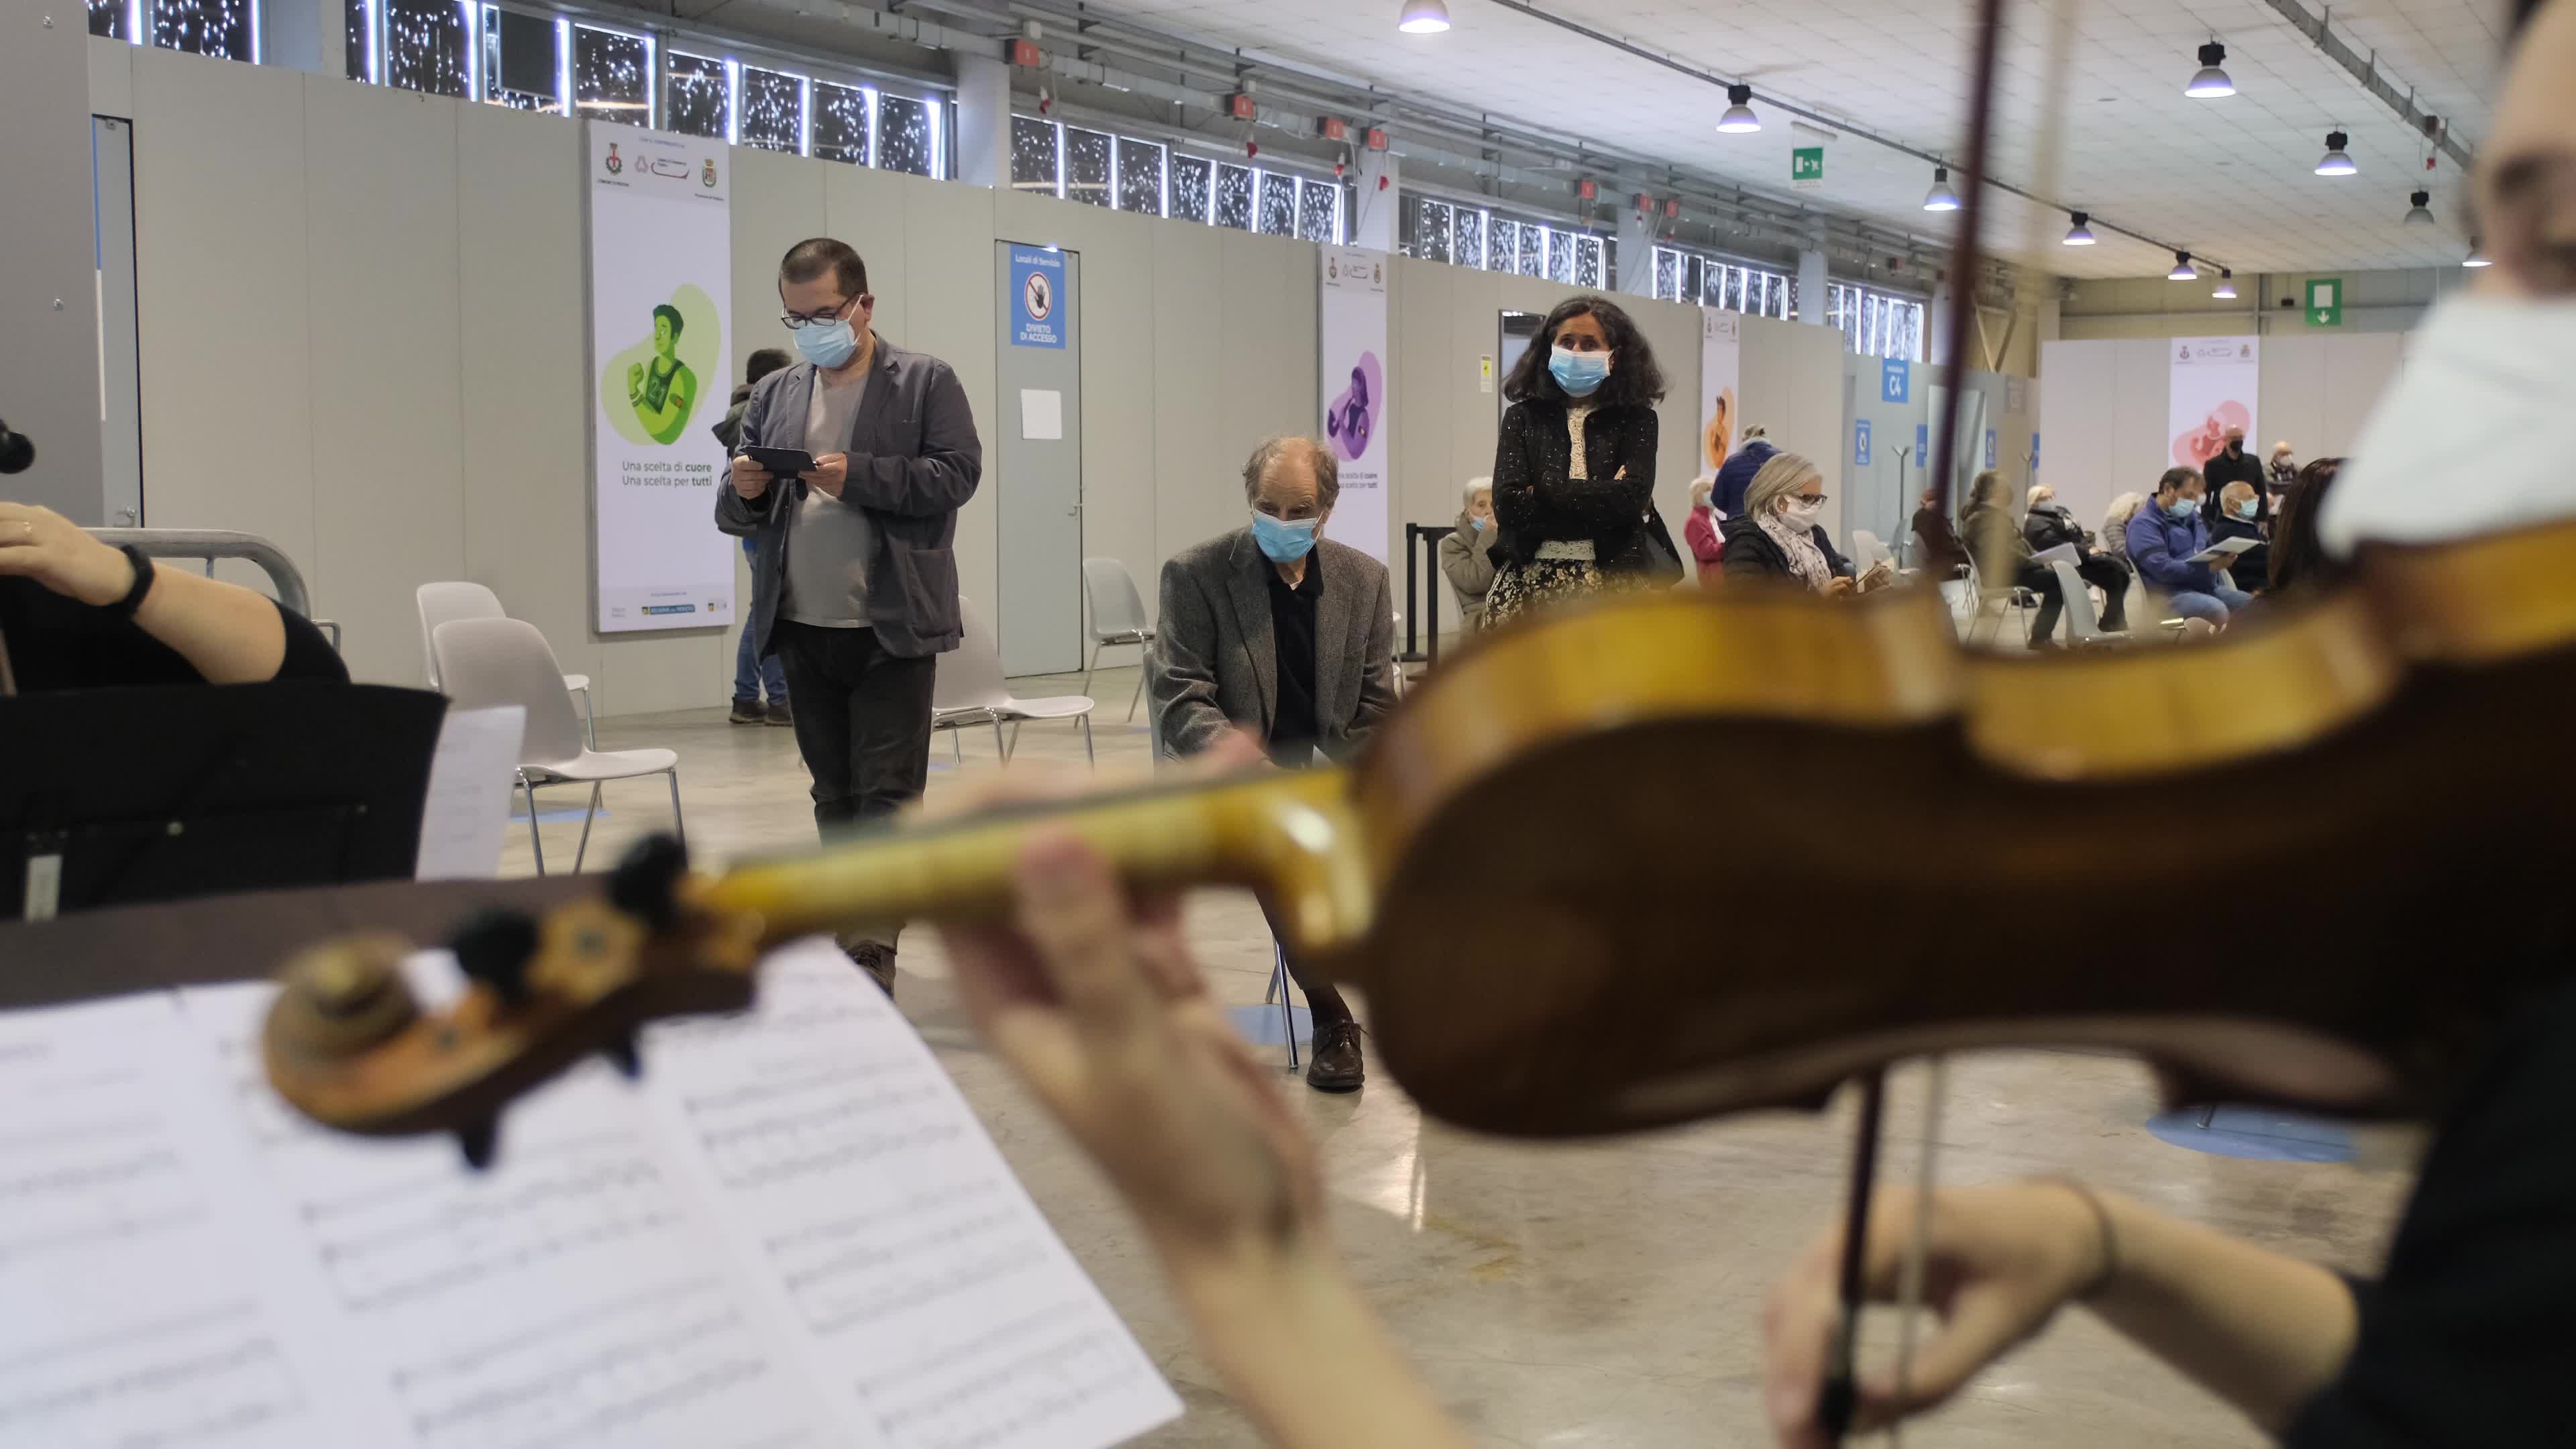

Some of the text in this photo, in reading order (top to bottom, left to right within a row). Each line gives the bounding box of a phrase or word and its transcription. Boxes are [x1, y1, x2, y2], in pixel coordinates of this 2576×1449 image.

[1026, 323, 1051, 333] DIVIETO
[1020, 331, 1057, 343] DI ACCESSO
[1889, 375, 1902, 397] C4
[622, 461, 712, 472] Una scelta di cuore
[622, 476, 712, 488] Una scelta per tutti
